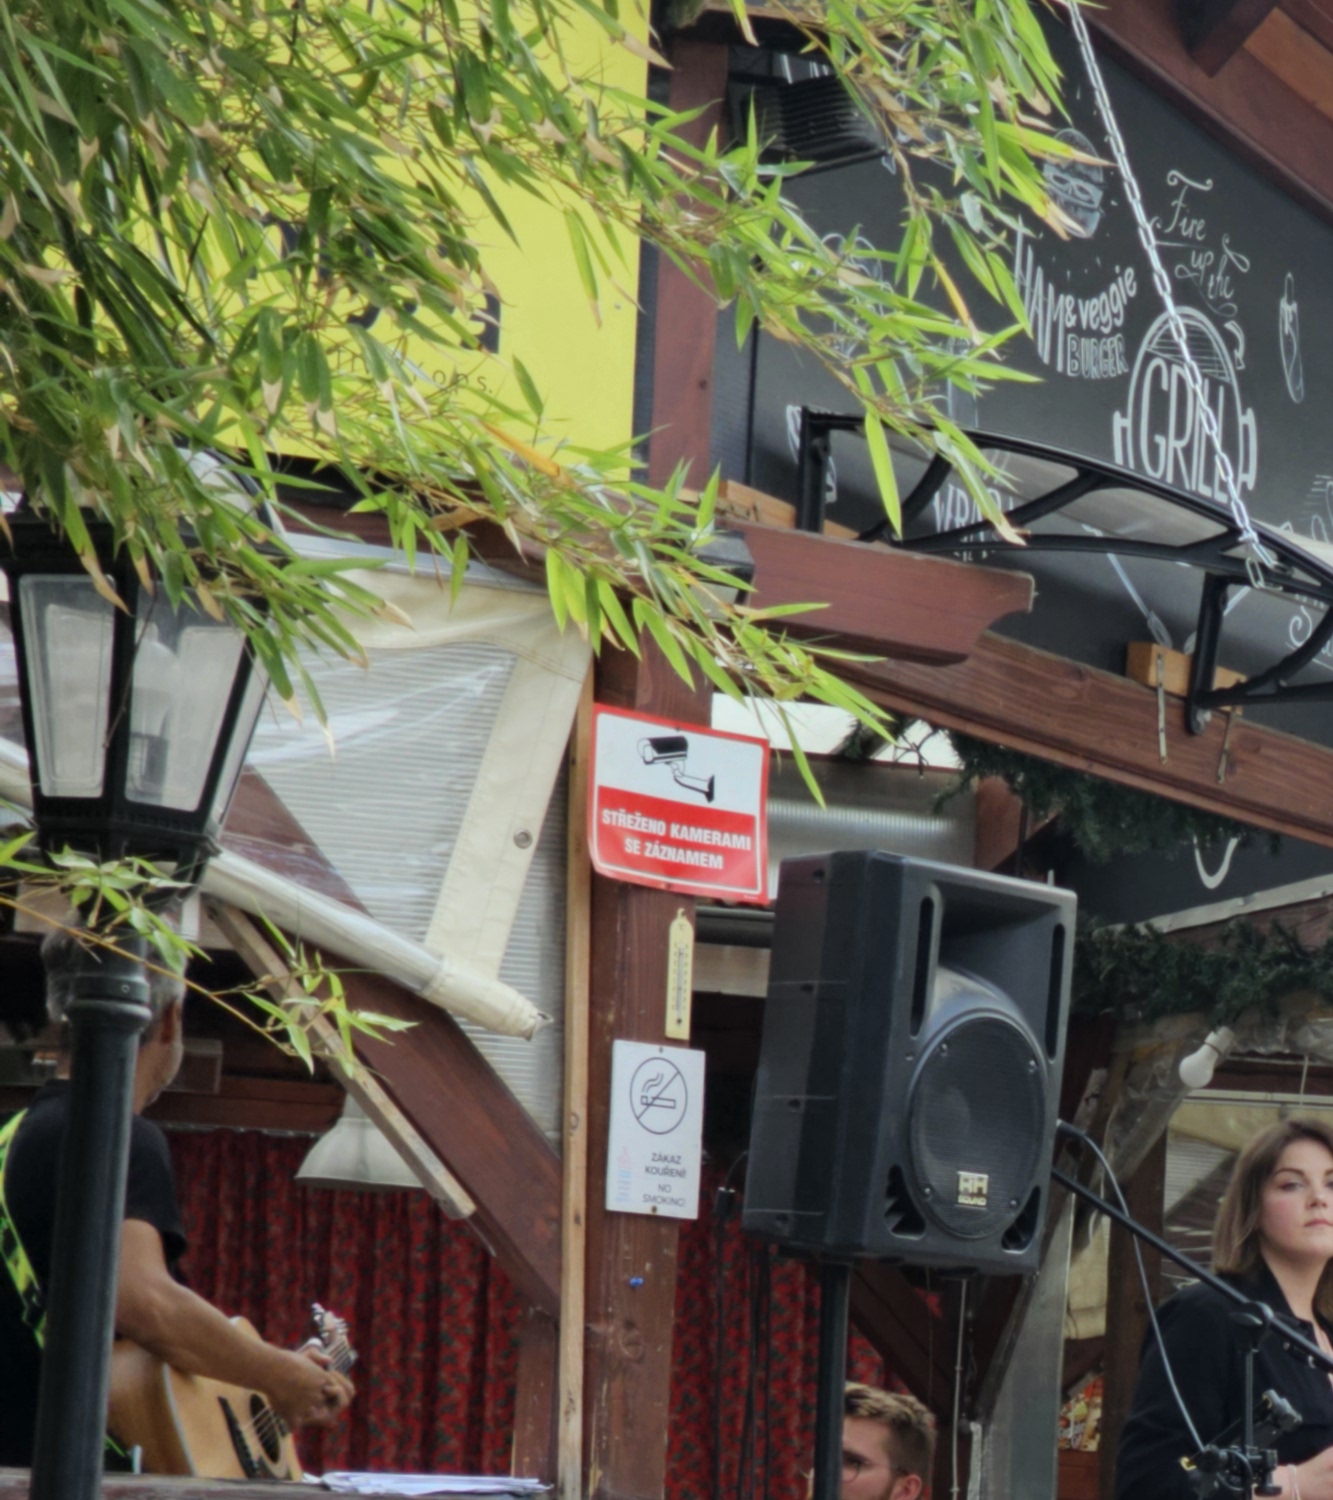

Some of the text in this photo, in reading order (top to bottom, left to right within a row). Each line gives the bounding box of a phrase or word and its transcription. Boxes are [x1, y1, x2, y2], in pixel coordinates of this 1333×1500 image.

[1151, 169, 1214, 240] Fire
[1065, 296, 1077, 328] &
[1077, 264, 1137, 335] veggie
[1066, 332, 1129, 380] BURGER
[1140, 357, 1232, 503] GRILL
[601, 807, 752, 851] STŘEŽENO KAMERAMI
[624, 836, 724, 870] SE ZÁZNAMEM
[651, 1151, 683, 1166] ZÁKAZ
[657, 1183, 673, 1194] NO
